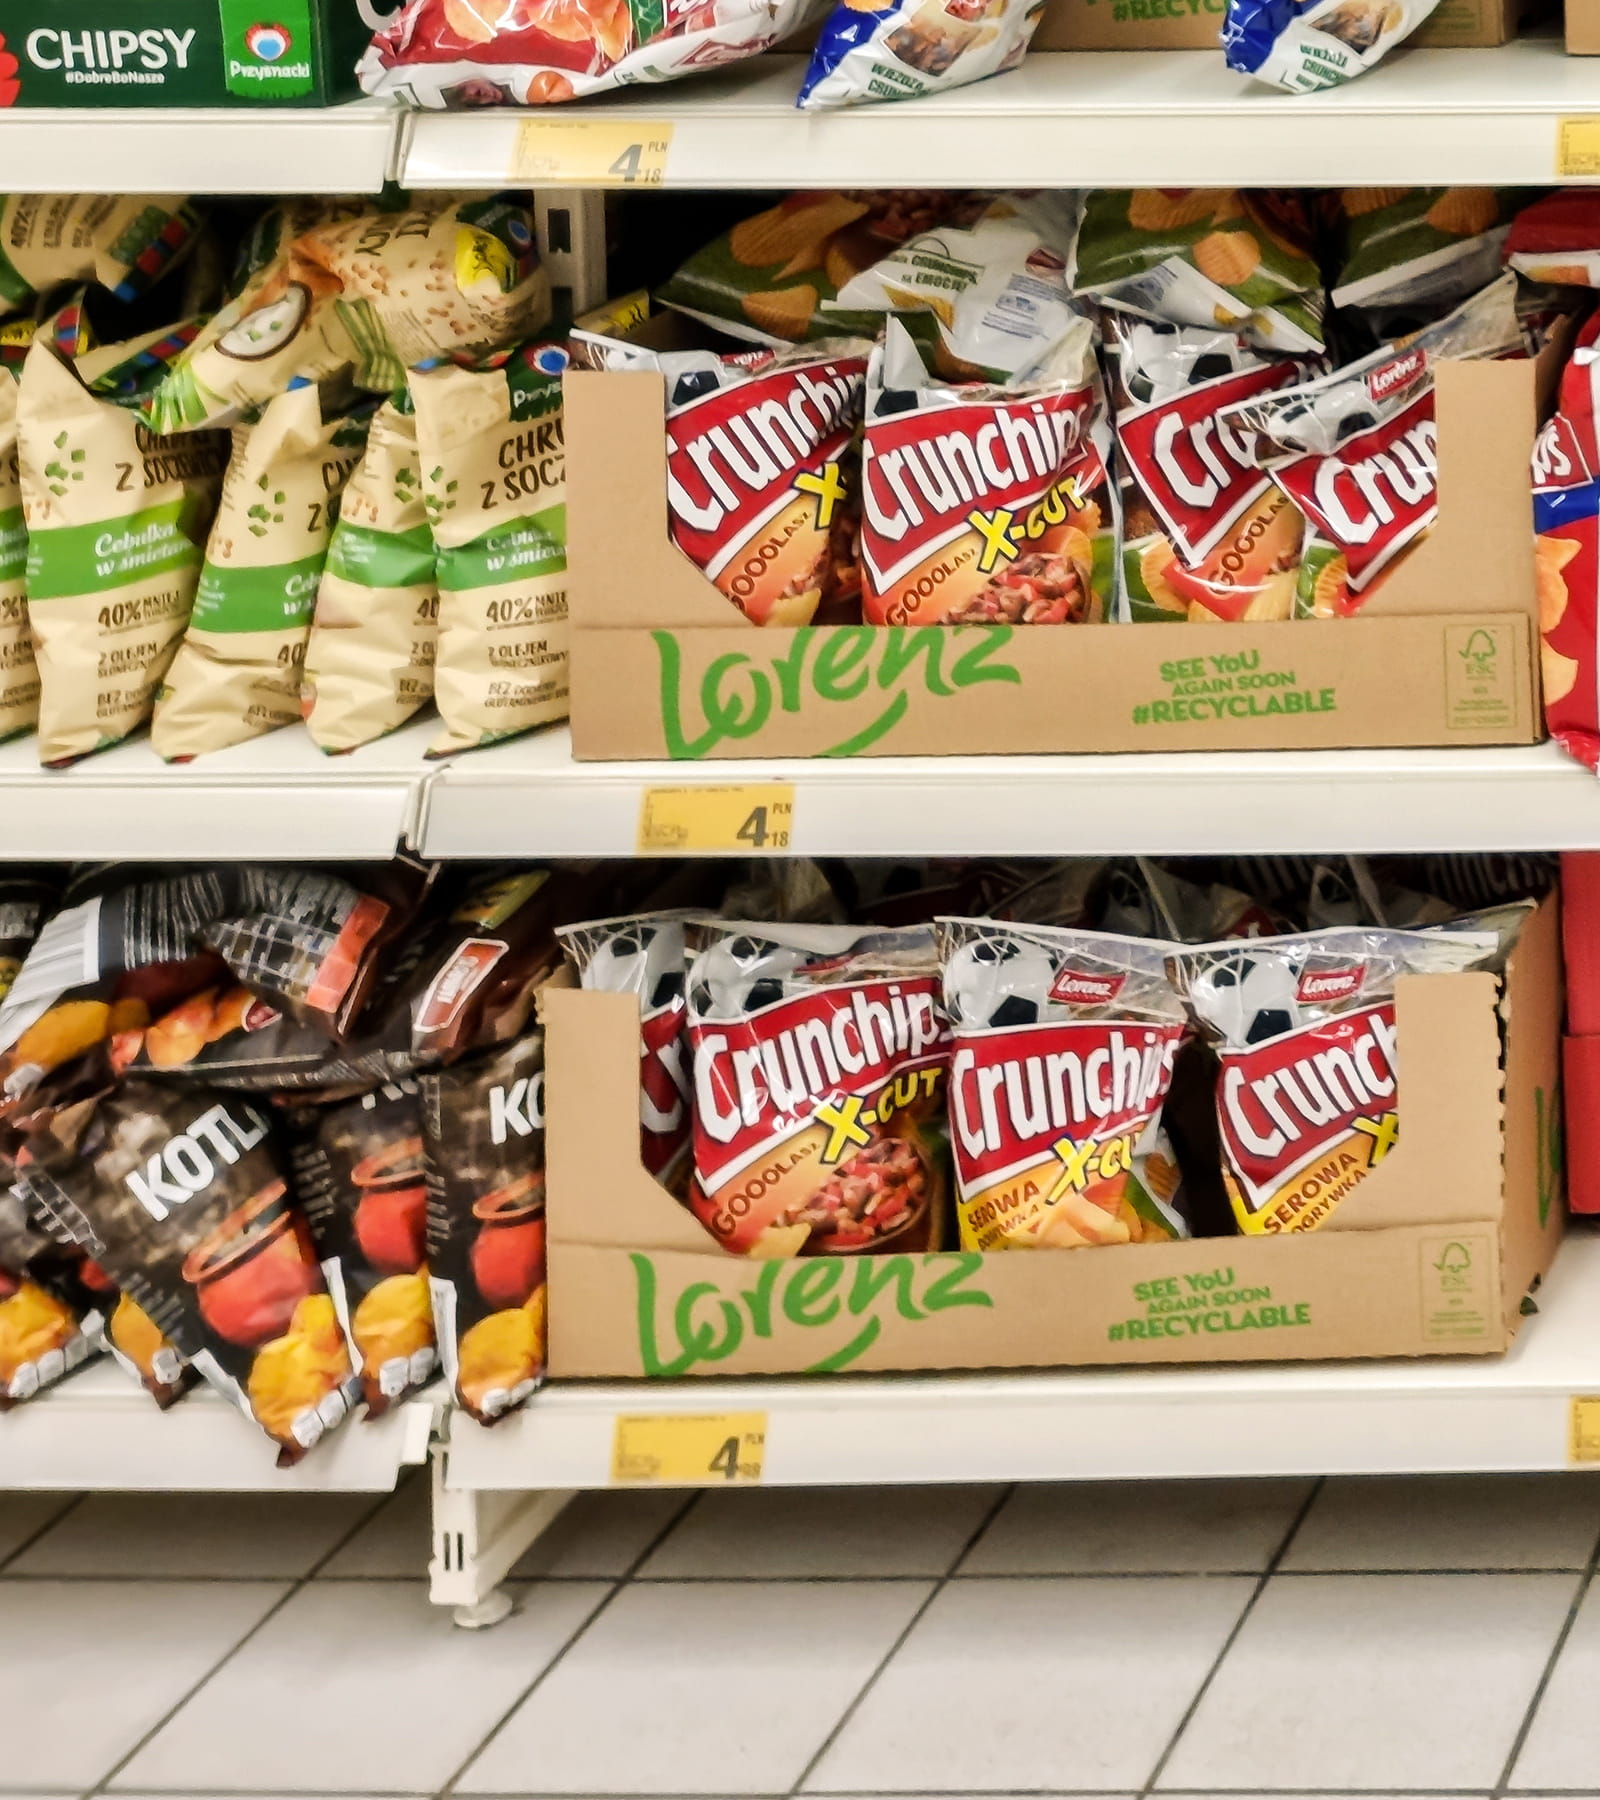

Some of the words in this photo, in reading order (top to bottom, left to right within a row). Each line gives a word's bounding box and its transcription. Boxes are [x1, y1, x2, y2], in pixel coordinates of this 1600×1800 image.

[26, 28, 196, 70] CHIPSY
[230, 61, 310, 81] Przysnacki
[609, 143, 642, 183] 4
[648, 140, 668, 153] PLN
[643, 166, 661, 184] 18
[967, 473, 1084, 574] X-CUT
[99, 601, 141, 628] 40%
[486, 599, 533, 623] 40%
[1159, 657, 1205, 683] SEE
[1172, 676, 1231, 699] AGAIN
[1238, 671, 1296, 689] SOON
[651, 625, 1020, 760] Lorenz
[1132, 688, 1337, 726] #RECYCLABLE
[736, 805, 768, 847] 4
[771, 832, 789, 846] 18
[1058, 973, 1114, 997] Lorenz
[1302, 972, 1356, 996] Lorenz
[814, 1067, 943, 1165] X-CUT
[1262, 1151, 1359, 1235] SEROWA
[1133, 1277, 1180, 1303] SEE
[1147, 1294, 1206, 1315] AGAIN
[1213, 1286, 1272, 1304] SOON
[630, 1252, 994, 1378] Lorenz
[1107, 1303, 1312, 1342] #RECYCLABLE
[708, 1436, 740, 1479] 4
